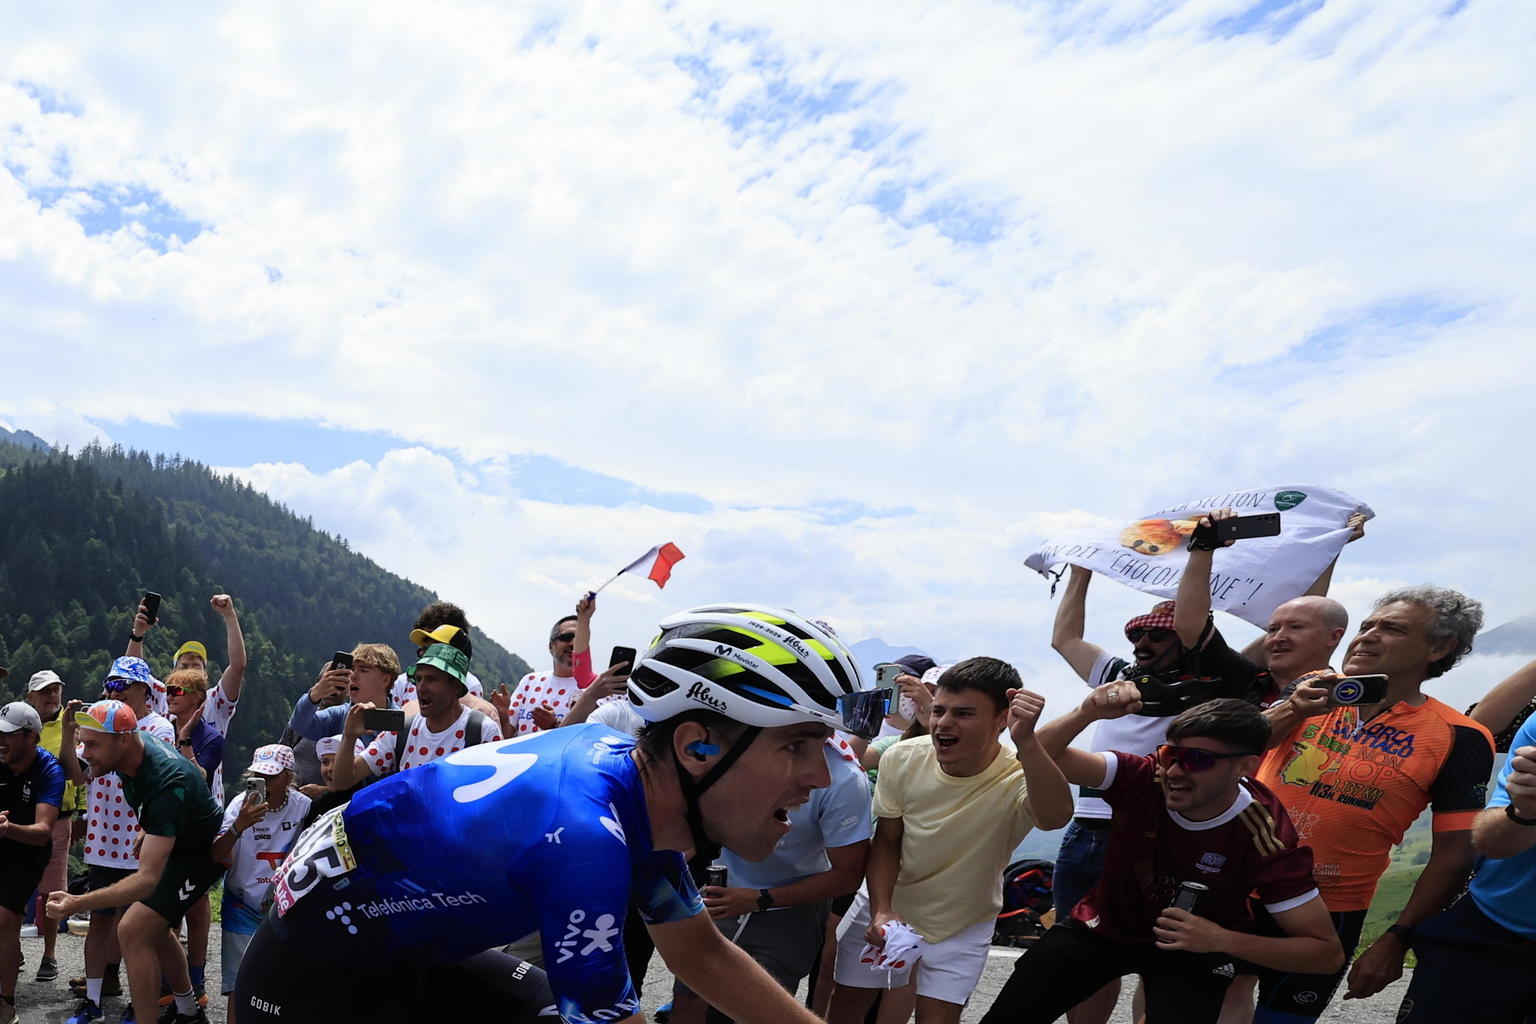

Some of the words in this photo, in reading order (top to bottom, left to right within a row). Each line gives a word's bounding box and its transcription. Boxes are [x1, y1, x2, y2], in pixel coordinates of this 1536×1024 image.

[733, 652, 760, 670] Movistar
[685, 681, 728, 714] Abus
[357, 895, 436, 919] Telefónica
[431, 890, 488, 908] Tech
[555, 909, 586, 964] vivo
[250, 995, 282, 1016] GOBIK
